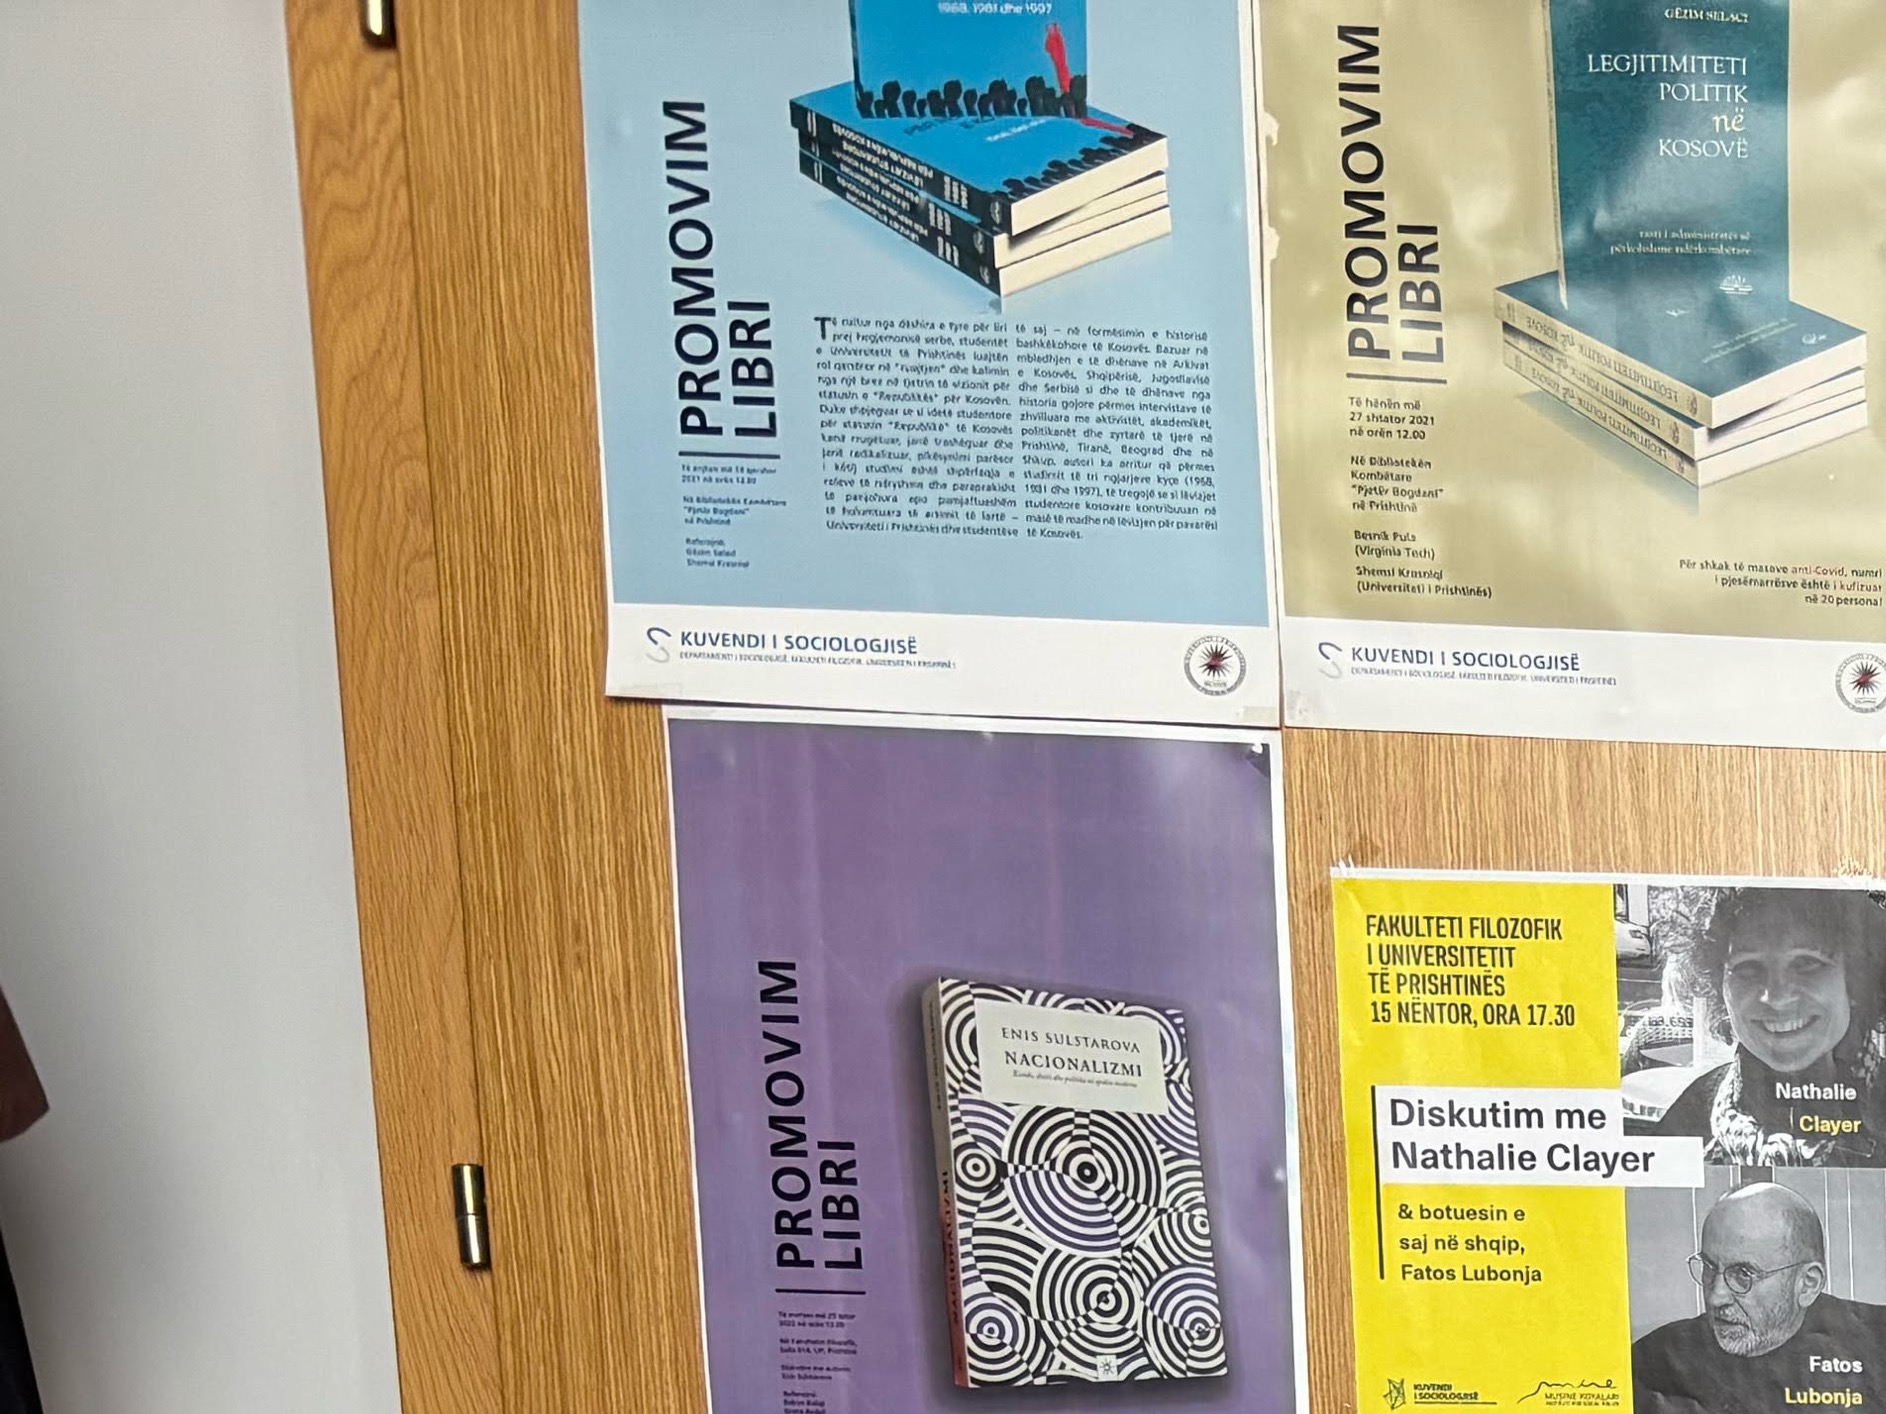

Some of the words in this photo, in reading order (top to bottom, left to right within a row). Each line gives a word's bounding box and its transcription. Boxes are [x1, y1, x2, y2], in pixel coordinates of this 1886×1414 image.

[1587, 53, 1748, 76] LEGJITIMITETI
[1660, 83, 1748, 103] POLITIK
[1712, 107, 1746, 133] në
[1658, 137, 1748, 159] KOSOVË
[1338, 26, 1390, 359] PROMOVIM
[662, 101, 723, 436] PROMOVIM
[1397, 224, 1444, 363] LIBRI
[727, 301, 777, 437] LIBRI
[1349, 397, 1362, 407] Të
[1404, 400, 1420, 410] më
[1349, 412, 1363, 422] 27
[1366, 413, 1405, 425] shtator
[1409, 415, 1435, 425] 2021
[1349, 426, 1364, 437] në
[1397, 430, 1425, 439] 12.00
[681, 631, 766, 649] KUVENDI
[773, 634, 777, 649] I
[784, 635, 918, 654] SOCIOLOGJISË
[1352, 647, 1434, 664] KUVENDI
[1441, 651, 1445, 665] I
[1452, 651, 1580, 671] SOCIOLOGJISË
[1366, 914, 1462, 939] FAKULTETI
[1470, 916, 1562, 940] FILOZOFIK
[1367, 944, 1372, 964] I
[1380, 944, 1516, 968] UNIVERSITETIT
[1368, 968, 1390, 994] TË
[1396, 970, 1506, 996] PRISHTINËS
[1371, 1001, 1391, 1022] 15
[1398, 997, 1478, 1027] NËNTOR,
[1482, 1004, 1520, 1025] ORA
[1527, 1004, 1575, 1026] 17.30
[1002, 1027, 1038, 1042] ENIS
[1046, 1033, 1140, 1053] SULSTAROVA
[1005, 1051, 1142, 1077] NACIONALIZMI
[1776, 1082, 1857, 1101] Nathalie
[758, 961, 815, 1268] PROMOVIM
[1390, 1099, 1544, 1129] Diskutim
[1555, 1108, 1606, 1129] me
[1800, 1116, 1861, 1134] Clayer
[1392, 1141, 1536, 1170] Nathalie
[1547, 1143, 1655, 1178] Clayer
[817, 1141, 863, 1269] LIBRI
[1398, 1204, 1413, 1220] &
[1420, 1204, 1507, 1221] botuesin
[1514, 1208, 1525, 1221] e
[1400, 1234, 1427, 1253] saj
[1435, 1235, 1458, 1250] në
[1465, 1235, 1525, 1255] shqip,
[1402, 1264, 1456, 1281] Fatos
[1462, 1265, 1542, 1285] Lubonja
[1809, 1355, 1863, 1373] Fatos
[1785, 1388, 1863, 1407] Lubonja
